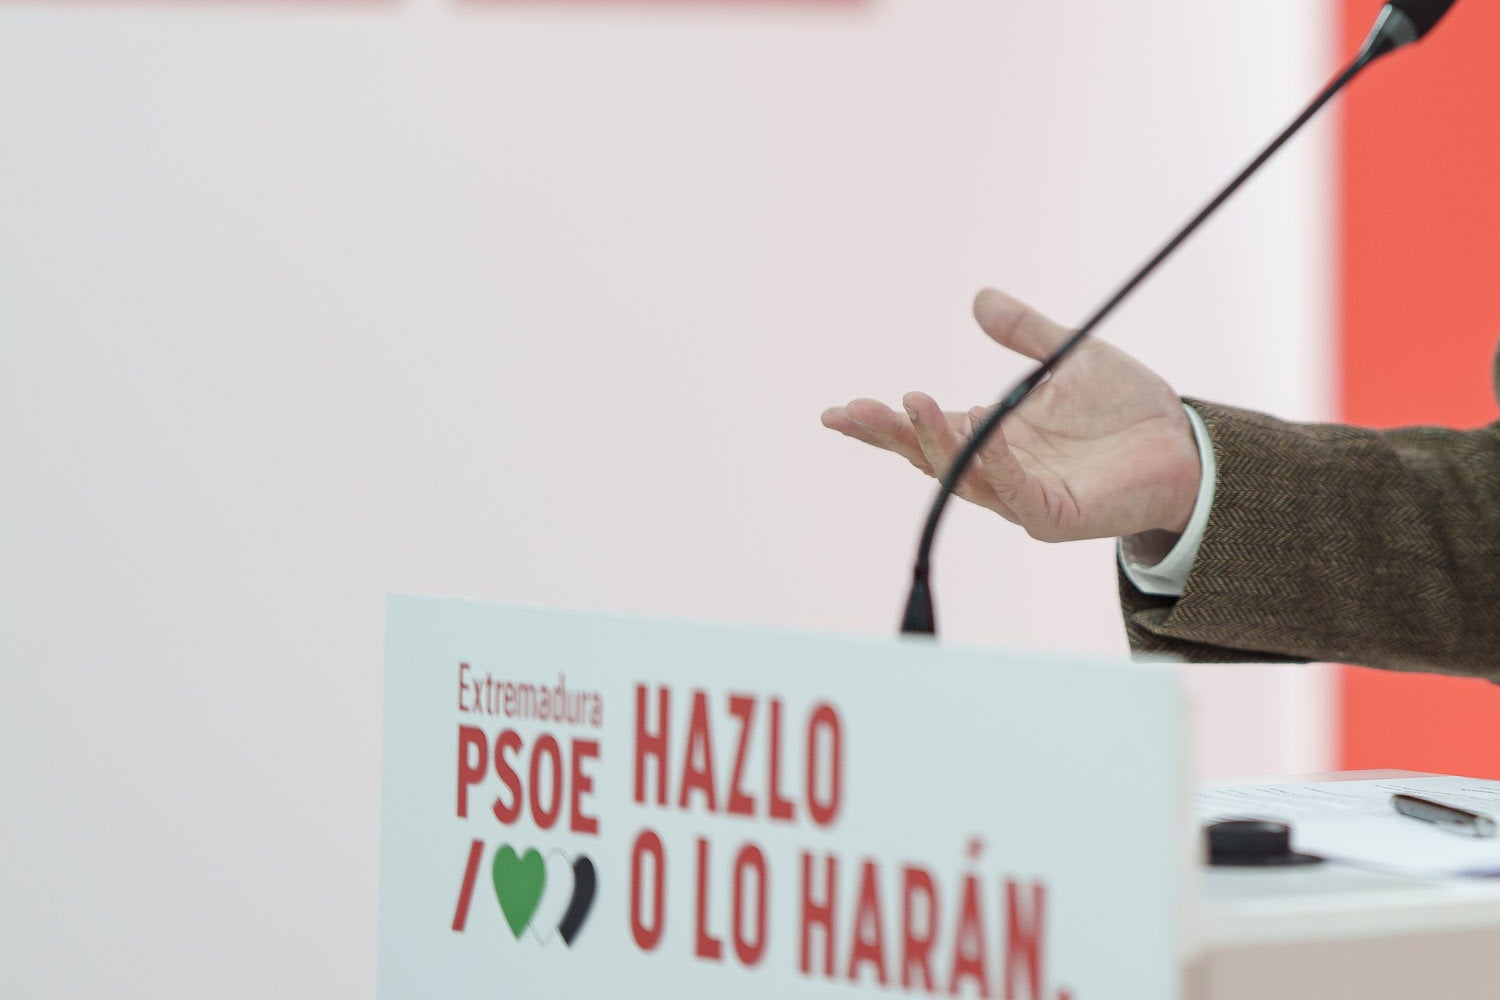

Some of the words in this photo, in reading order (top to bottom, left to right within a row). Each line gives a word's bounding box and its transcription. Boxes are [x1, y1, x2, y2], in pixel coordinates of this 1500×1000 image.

[457, 662, 603, 727] Extremadura
[634, 682, 845, 828] HAZLO
[456, 723, 600, 835] PSOE
[630, 828, 666, 953] O
[694, 836, 768, 967] LO
